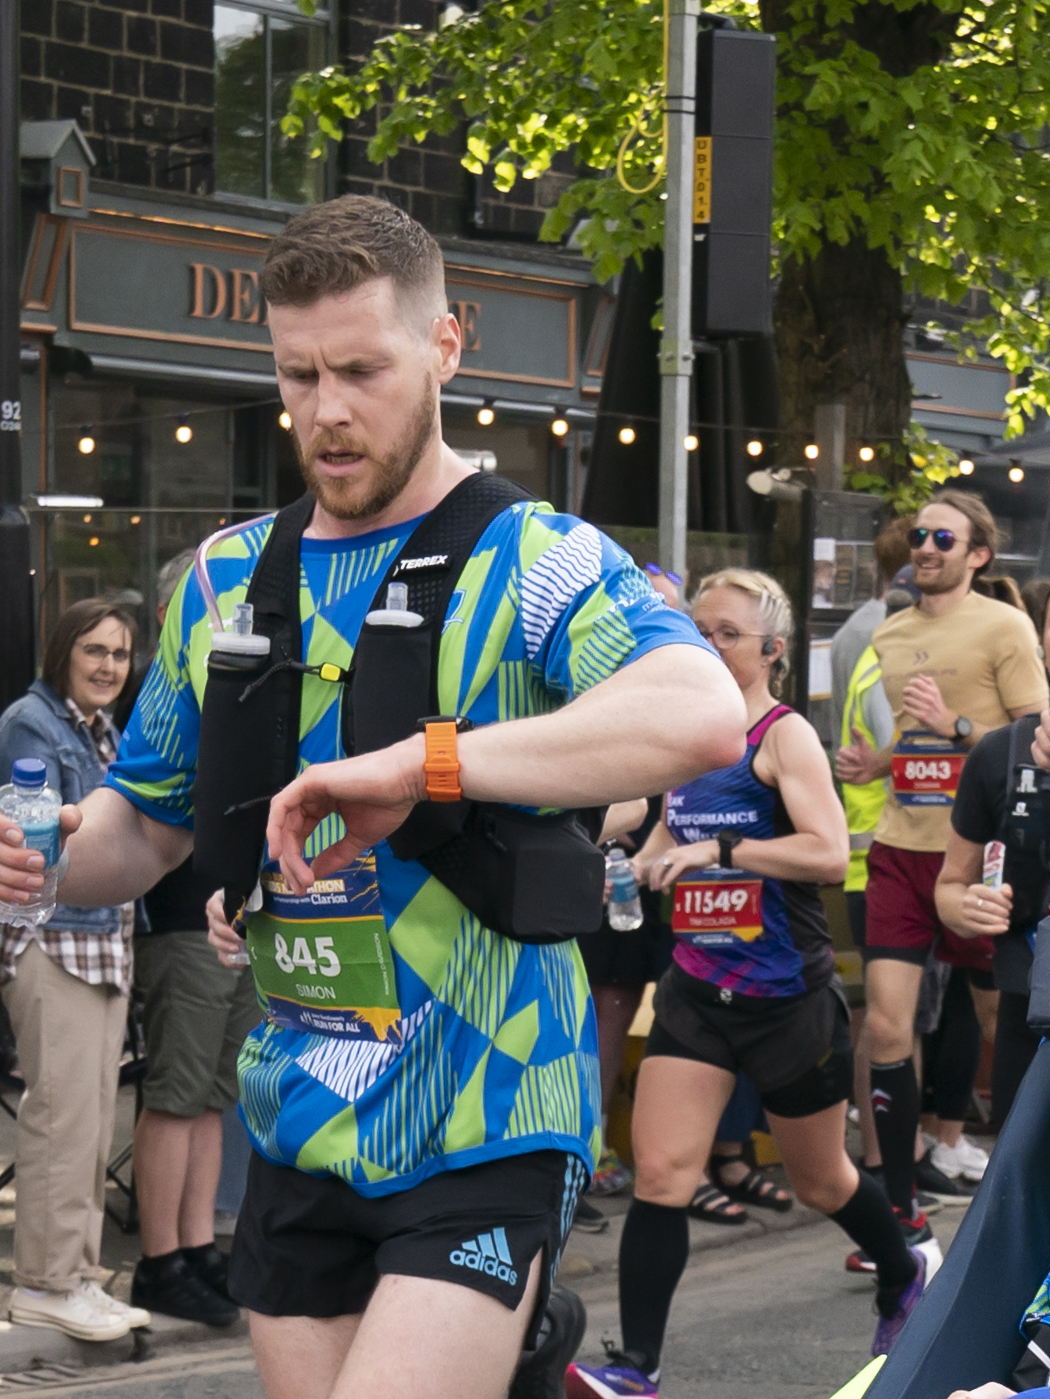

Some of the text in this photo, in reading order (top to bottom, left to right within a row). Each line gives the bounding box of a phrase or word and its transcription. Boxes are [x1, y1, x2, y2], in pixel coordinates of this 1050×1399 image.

[400, 554, 449, 571] TERREX
[904, 760, 951, 780] 8043
[310, 891, 348, 906] Clarion
[684, 888, 749, 915] 11549
[274, 932, 342, 977] 845
[295, 983, 337, 1000] SIMON
[449, 1249, 518, 1286] adidas
